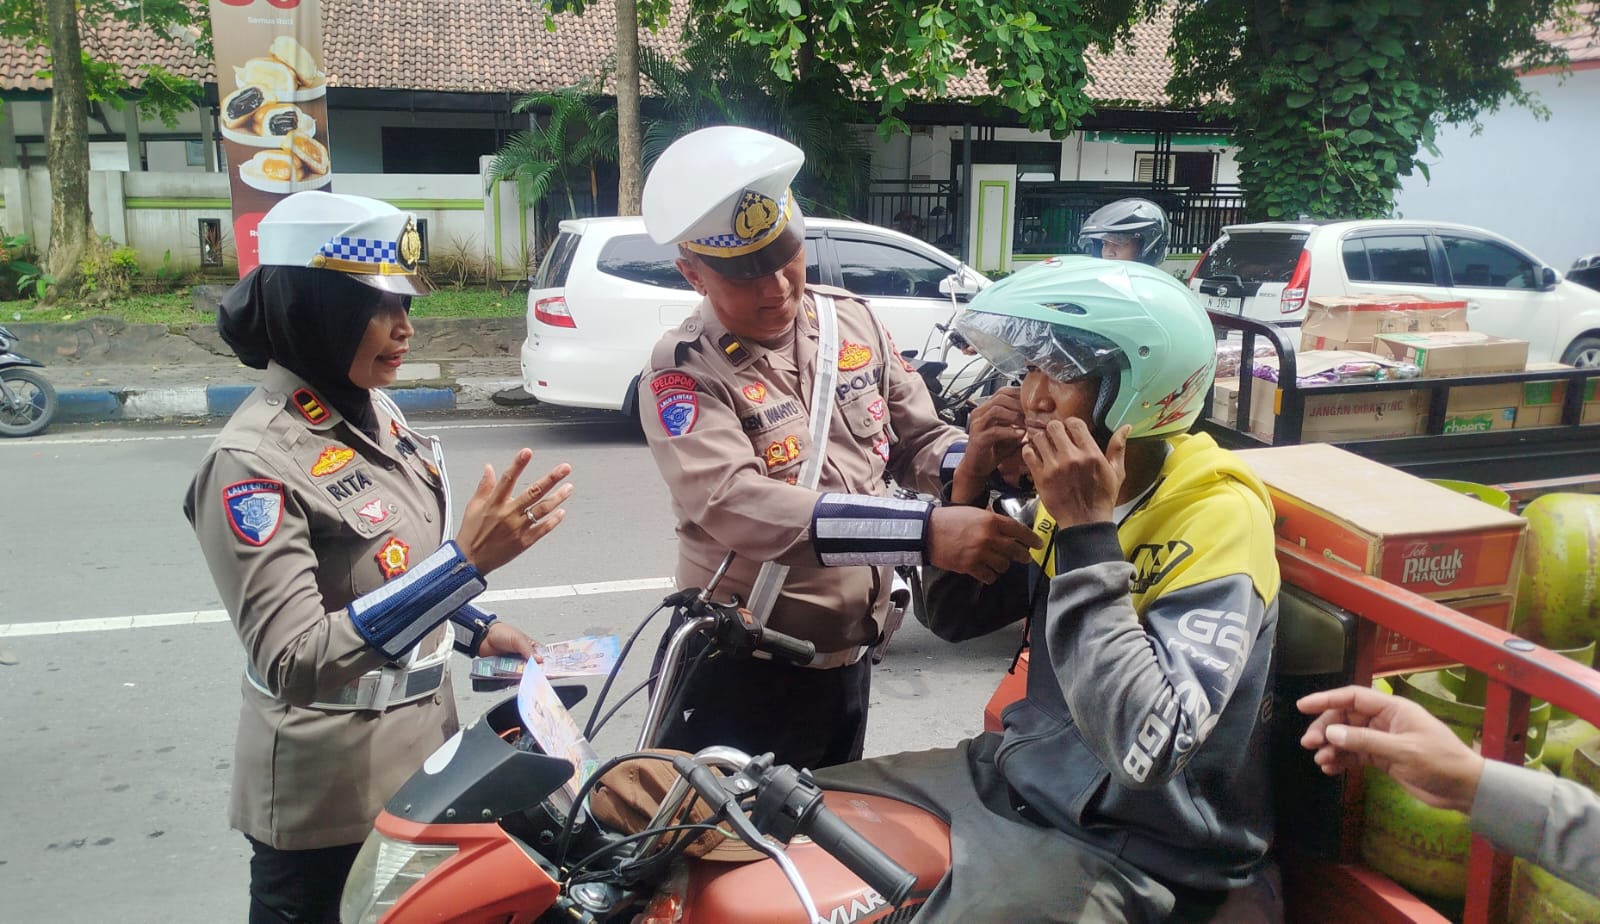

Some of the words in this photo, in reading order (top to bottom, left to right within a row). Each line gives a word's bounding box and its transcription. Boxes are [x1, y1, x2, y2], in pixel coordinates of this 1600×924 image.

[654, 376, 694, 390] PELOPOR
[764, 400, 799, 425] WAHYU
[1310, 405, 1351, 417] JANGAN
[228, 484, 248, 497] LALU
[250, 482, 279, 490] LINTAS
[326, 470, 372, 501] RITA
[1411, 569, 1456, 586] HARUM
